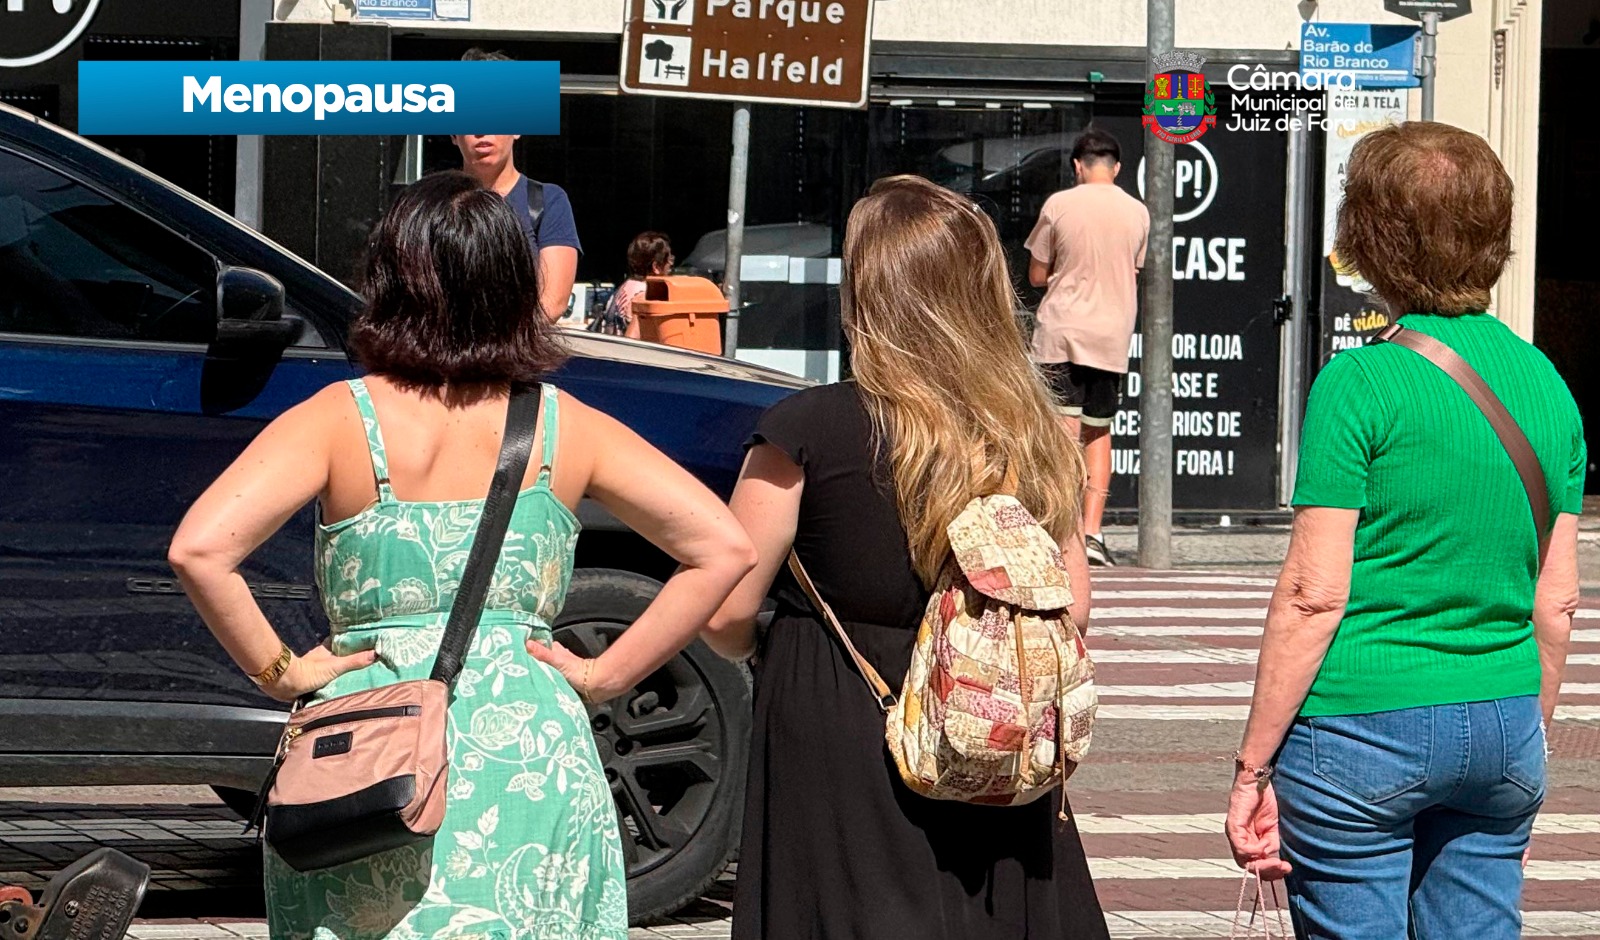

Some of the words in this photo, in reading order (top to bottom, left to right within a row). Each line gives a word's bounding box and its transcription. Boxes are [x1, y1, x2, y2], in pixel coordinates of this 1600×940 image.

[706, 0, 845, 28] Parque
[1304, 25, 1331, 38] Av.
[1303, 40, 1350, 53] Barão
[702, 48, 843, 86] Halfeld
[1303, 55, 1329, 68] Rio
[1334, 55, 1389, 69] Branco
[1373, 97, 1401, 109] TELA
[1172, 160, 1203, 199] P!
[1172, 236, 1246, 281] CASE
[1334, 312, 1352, 332] DÊ
[1353, 310, 1389, 332] vida
[1200, 334, 1243, 360] LOJA
[1332, 336, 1363, 350] PARA
[1171, 372, 1203, 398] ASE
[1206, 373, 1219, 398] E
[1217, 411, 1242, 437] DE
[1176, 450, 1224, 476] FORA
